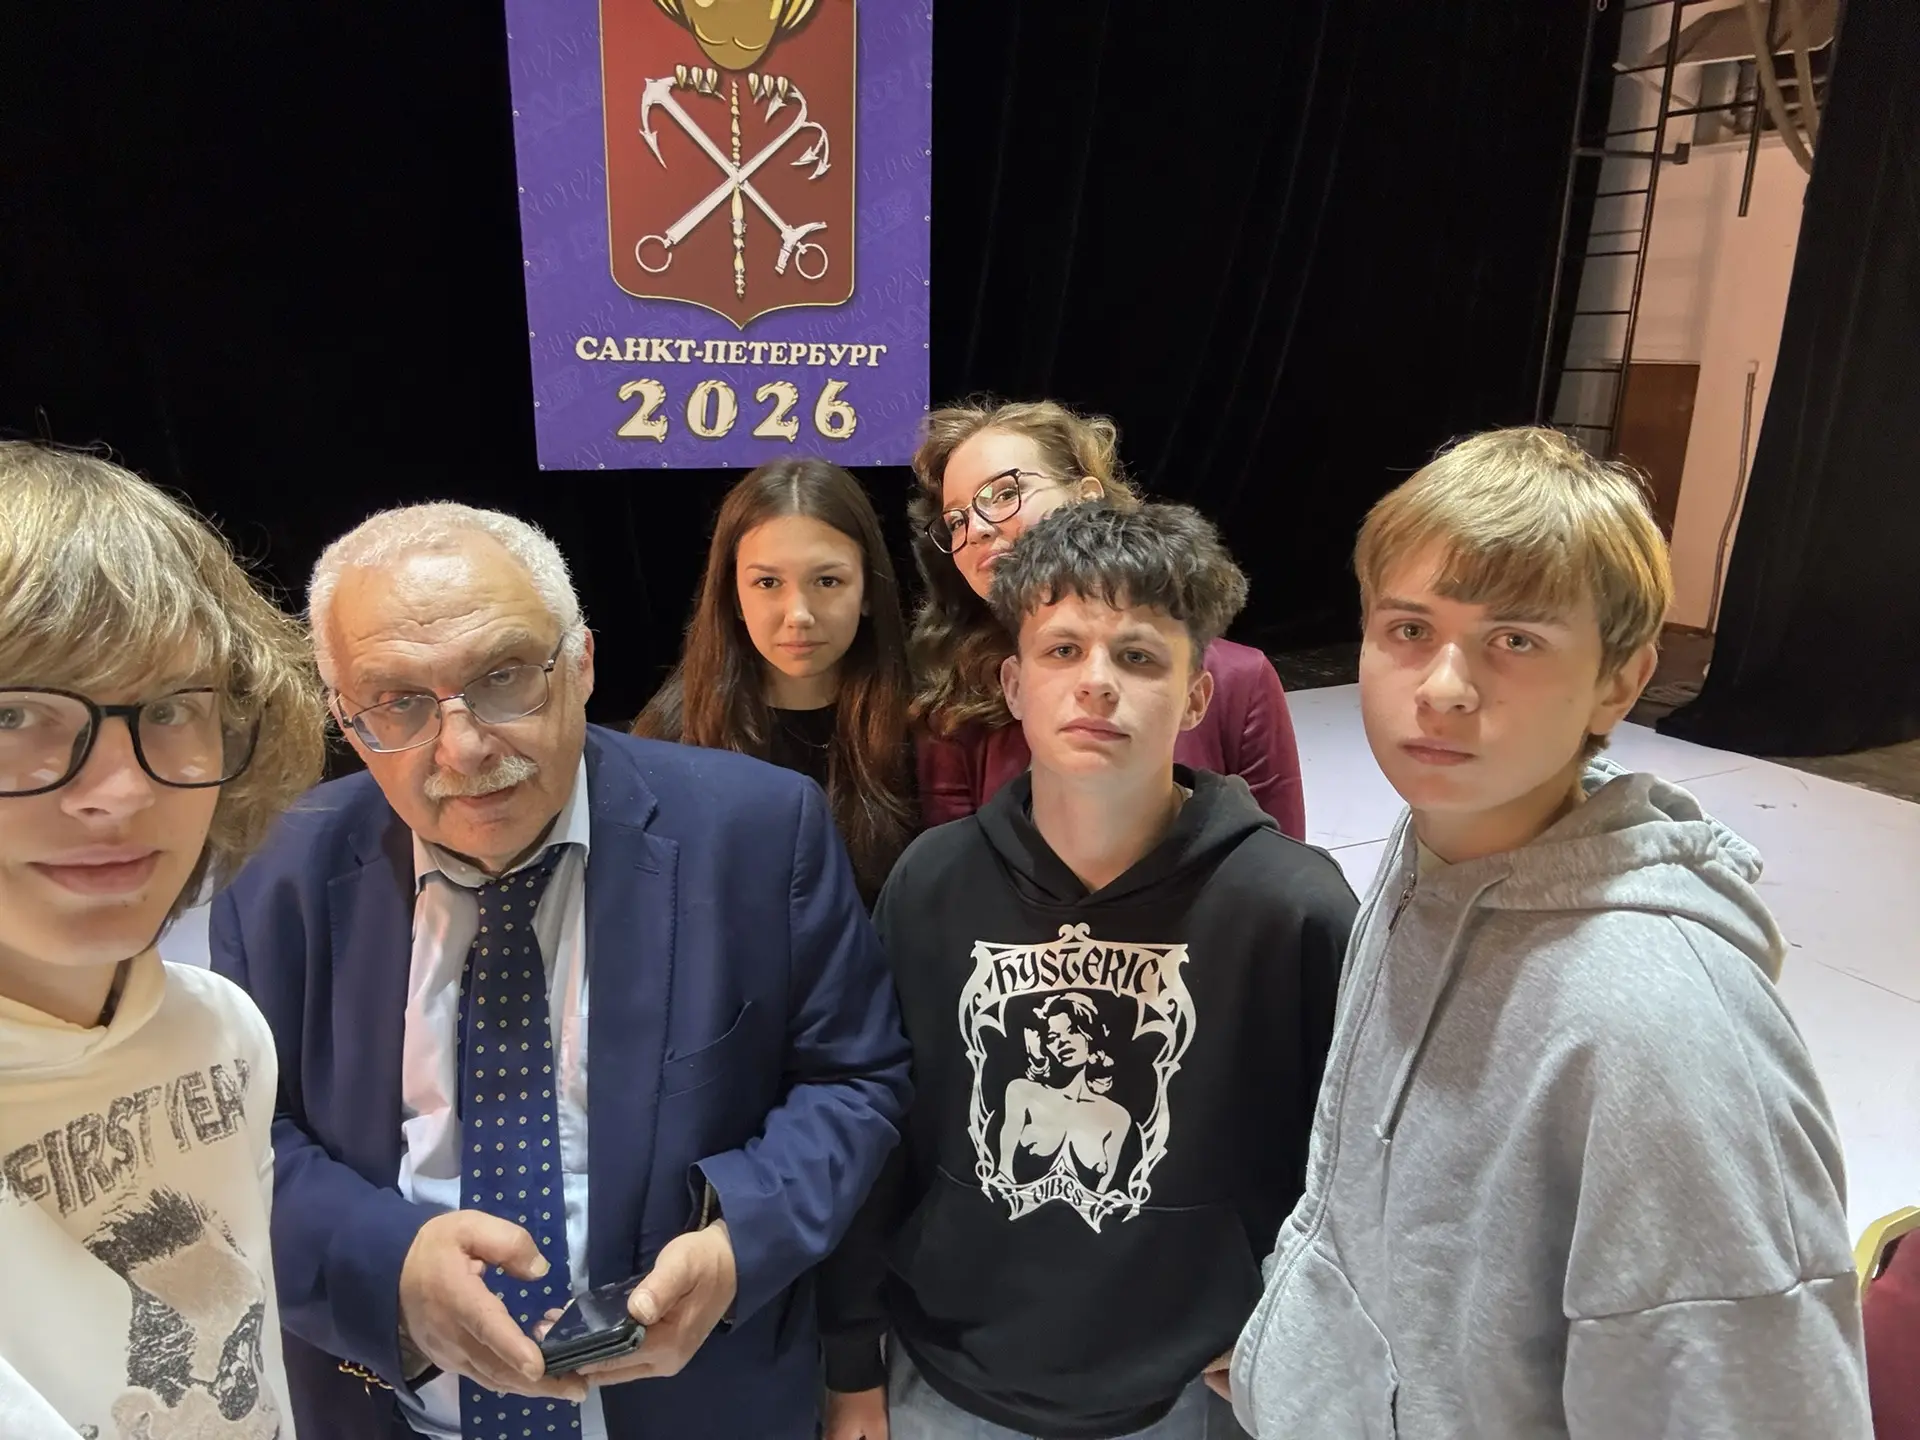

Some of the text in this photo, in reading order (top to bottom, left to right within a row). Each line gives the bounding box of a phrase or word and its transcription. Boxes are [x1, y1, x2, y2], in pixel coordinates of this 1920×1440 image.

[575, 336, 887, 366] САНКТ-ПЕТЕРБУРГ
[617, 378, 857, 443] 2026
[3, 1085, 162, 1219] FIRST
